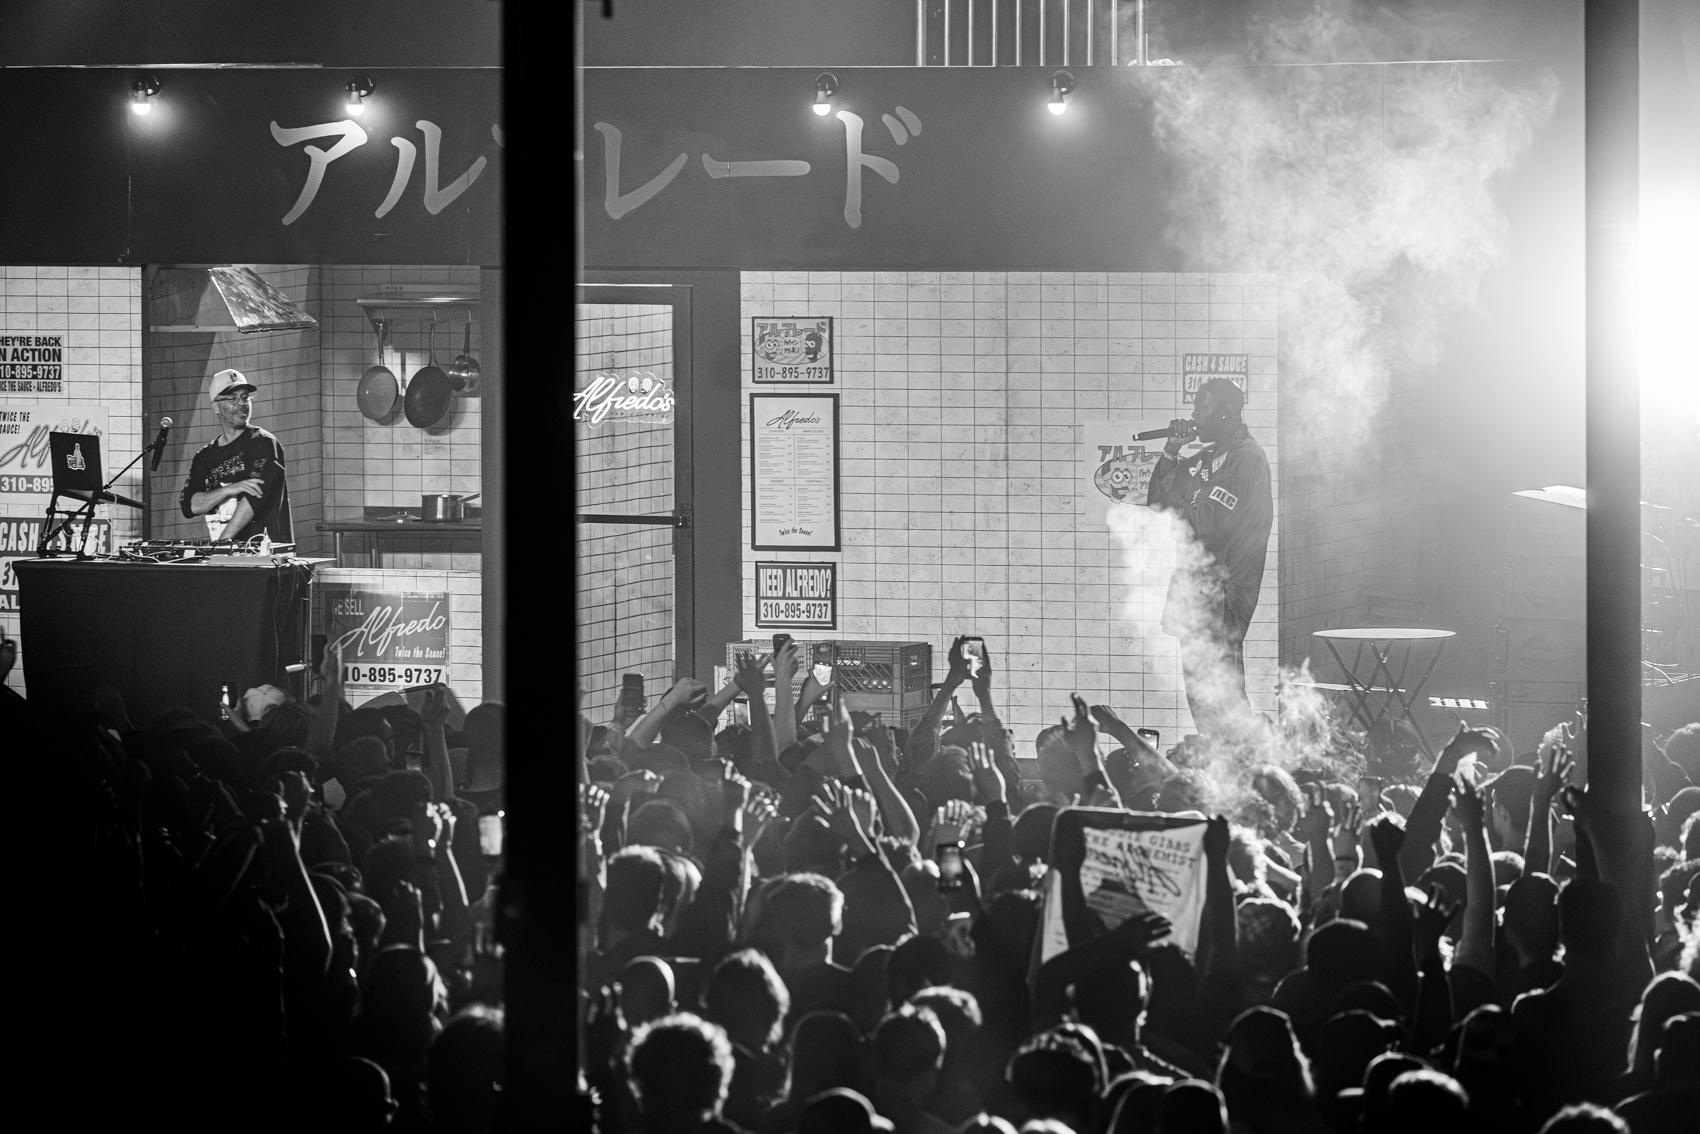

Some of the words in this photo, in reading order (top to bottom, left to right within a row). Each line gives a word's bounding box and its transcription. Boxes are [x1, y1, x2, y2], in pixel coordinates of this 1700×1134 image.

[269, 105, 922, 228] アルレード
[757, 322, 827, 337] アルフレード
[0, 336, 32, 347] HEY'RE
[35, 336, 61, 347] BACK
[11, 347, 61, 362] ACTION
[0, 365, 61, 379] 10-895-9737
[1210, 356, 1216, 372] 4
[1218, 356, 1247, 372] SAUCE
[757, 366, 829, 379] 310-895-9737
[573, 376, 675, 423] Alfredo's
[0, 412, 17, 422] TWICE
[20, 412, 30, 422] THE
[766, 409, 821, 430] Alfredo's
[0, 424, 20, 434] SAUCE!
[759, 568, 784, 598] NEED
[785, 568, 832, 598] ALFREDO?
[344, 599, 364, 616] SELL
[763, 602, 829, 619] 310-895-9737
[330, 601, 447, 657] Alfredo
[395, 646, 412, 658] Twice
[413, 646, 424, 658] the
[425, 647, 446, 659] Sauce!
[344, 666, 442, 684] 10-895-9737
